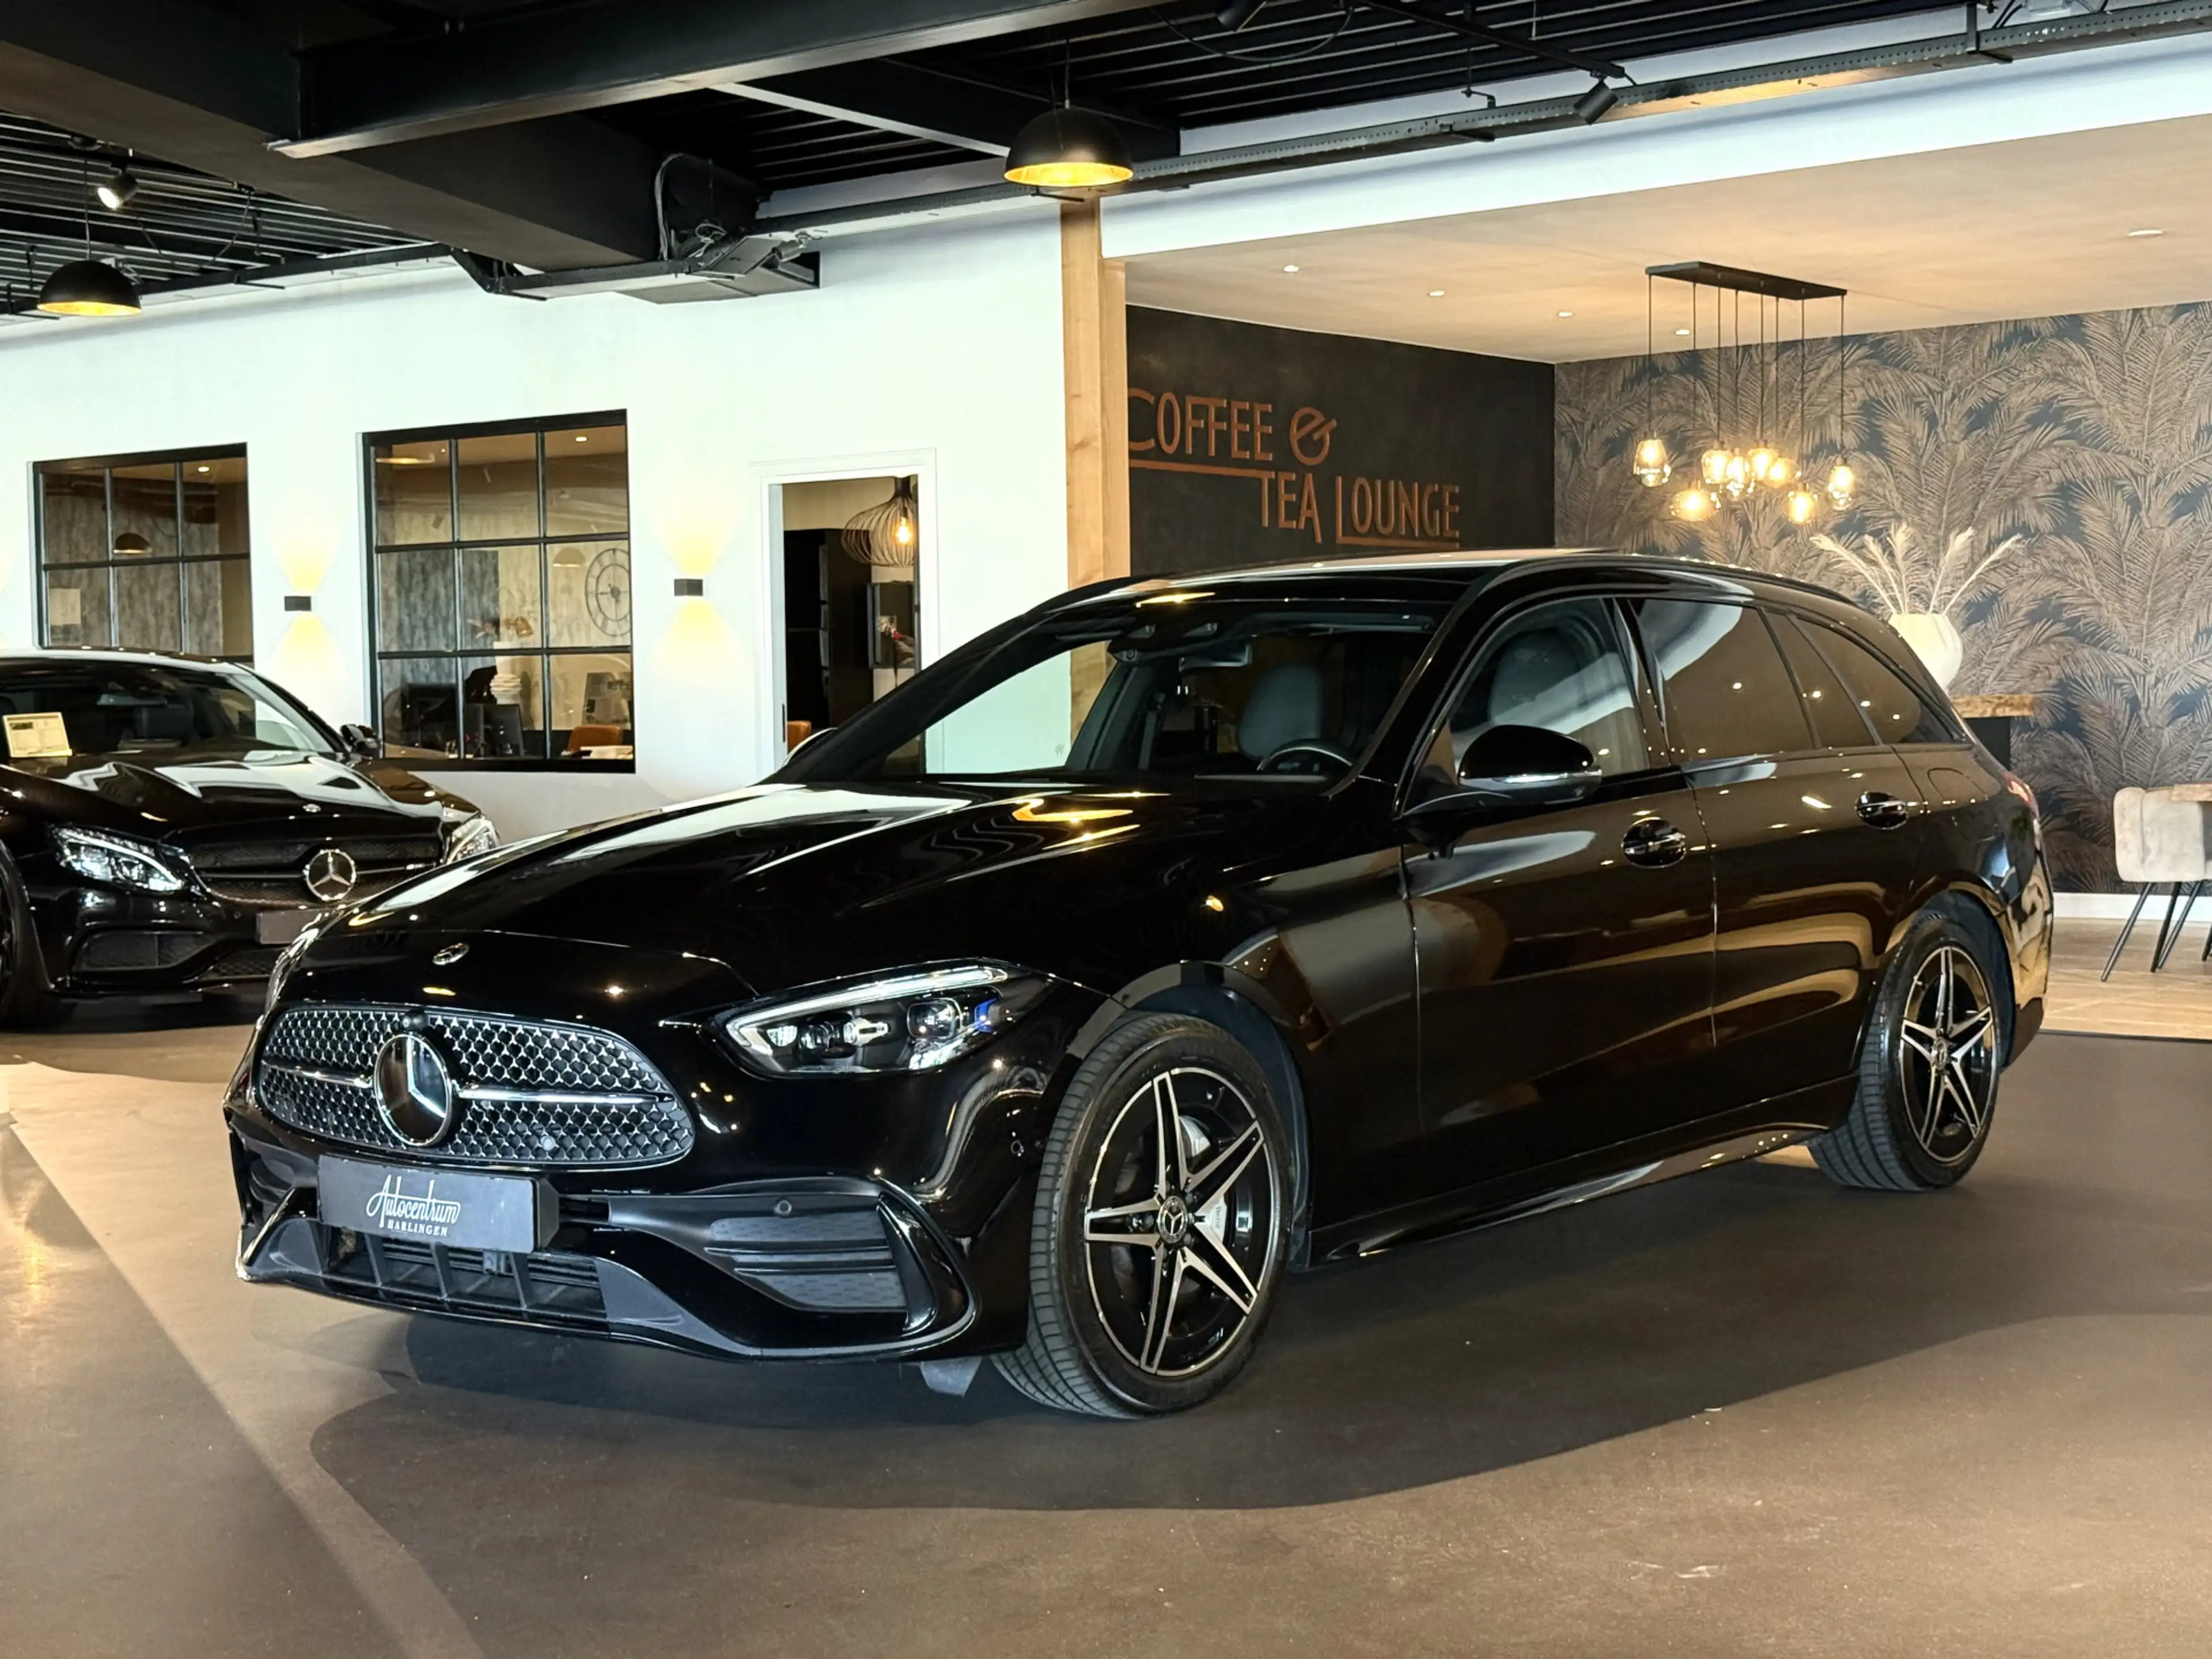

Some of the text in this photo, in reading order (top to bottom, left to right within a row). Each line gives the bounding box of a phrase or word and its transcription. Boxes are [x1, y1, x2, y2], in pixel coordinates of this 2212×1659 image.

[1256, 472, 1460, 548] TEA LOUNGE
[366, 1174, 460, 1228] Autocentrum
[387, 1219, 448, 1236] HARLINGEN
